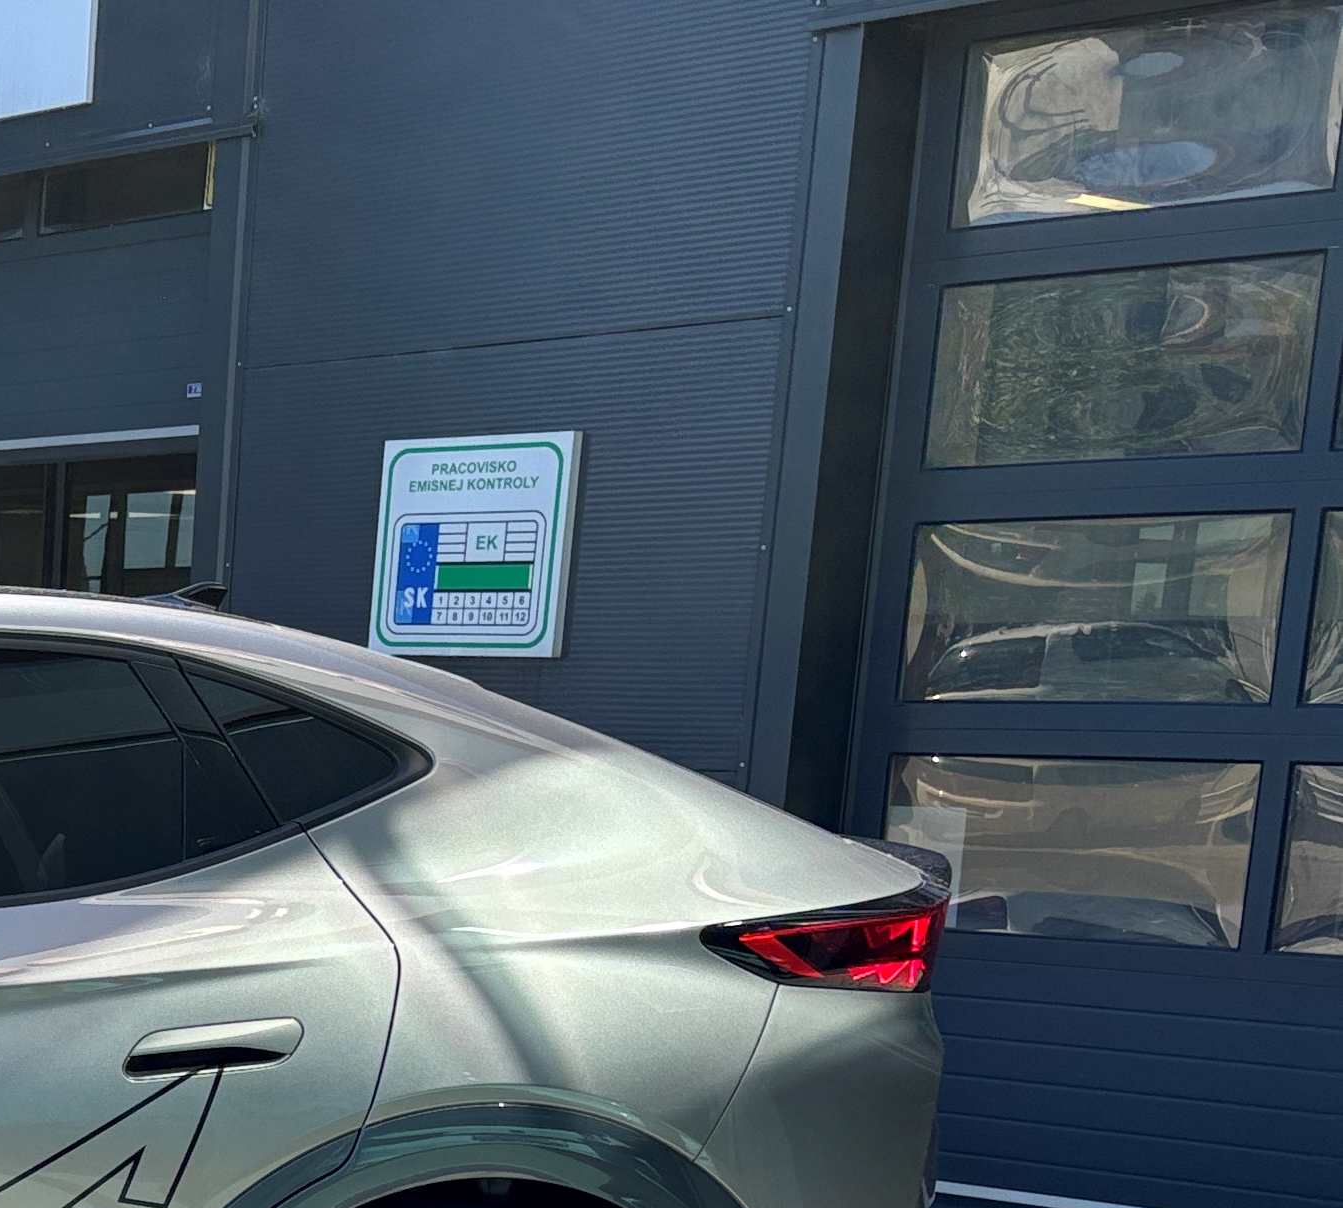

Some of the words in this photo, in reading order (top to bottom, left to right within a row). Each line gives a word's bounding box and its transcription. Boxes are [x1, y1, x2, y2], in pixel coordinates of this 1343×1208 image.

[431, 460, 517, 475] PRACOVISKO
[409, 479, 463, 493] EMISNEJ
[466, 476, 540, 491] KONTROLY
[475, 535, 499, 551] EK
[403, 586, 429, 609] SK
[482, 611, 493, 620] 10
[499, 611, 509, 620] 11
[515, 610, 526, 620] 12
